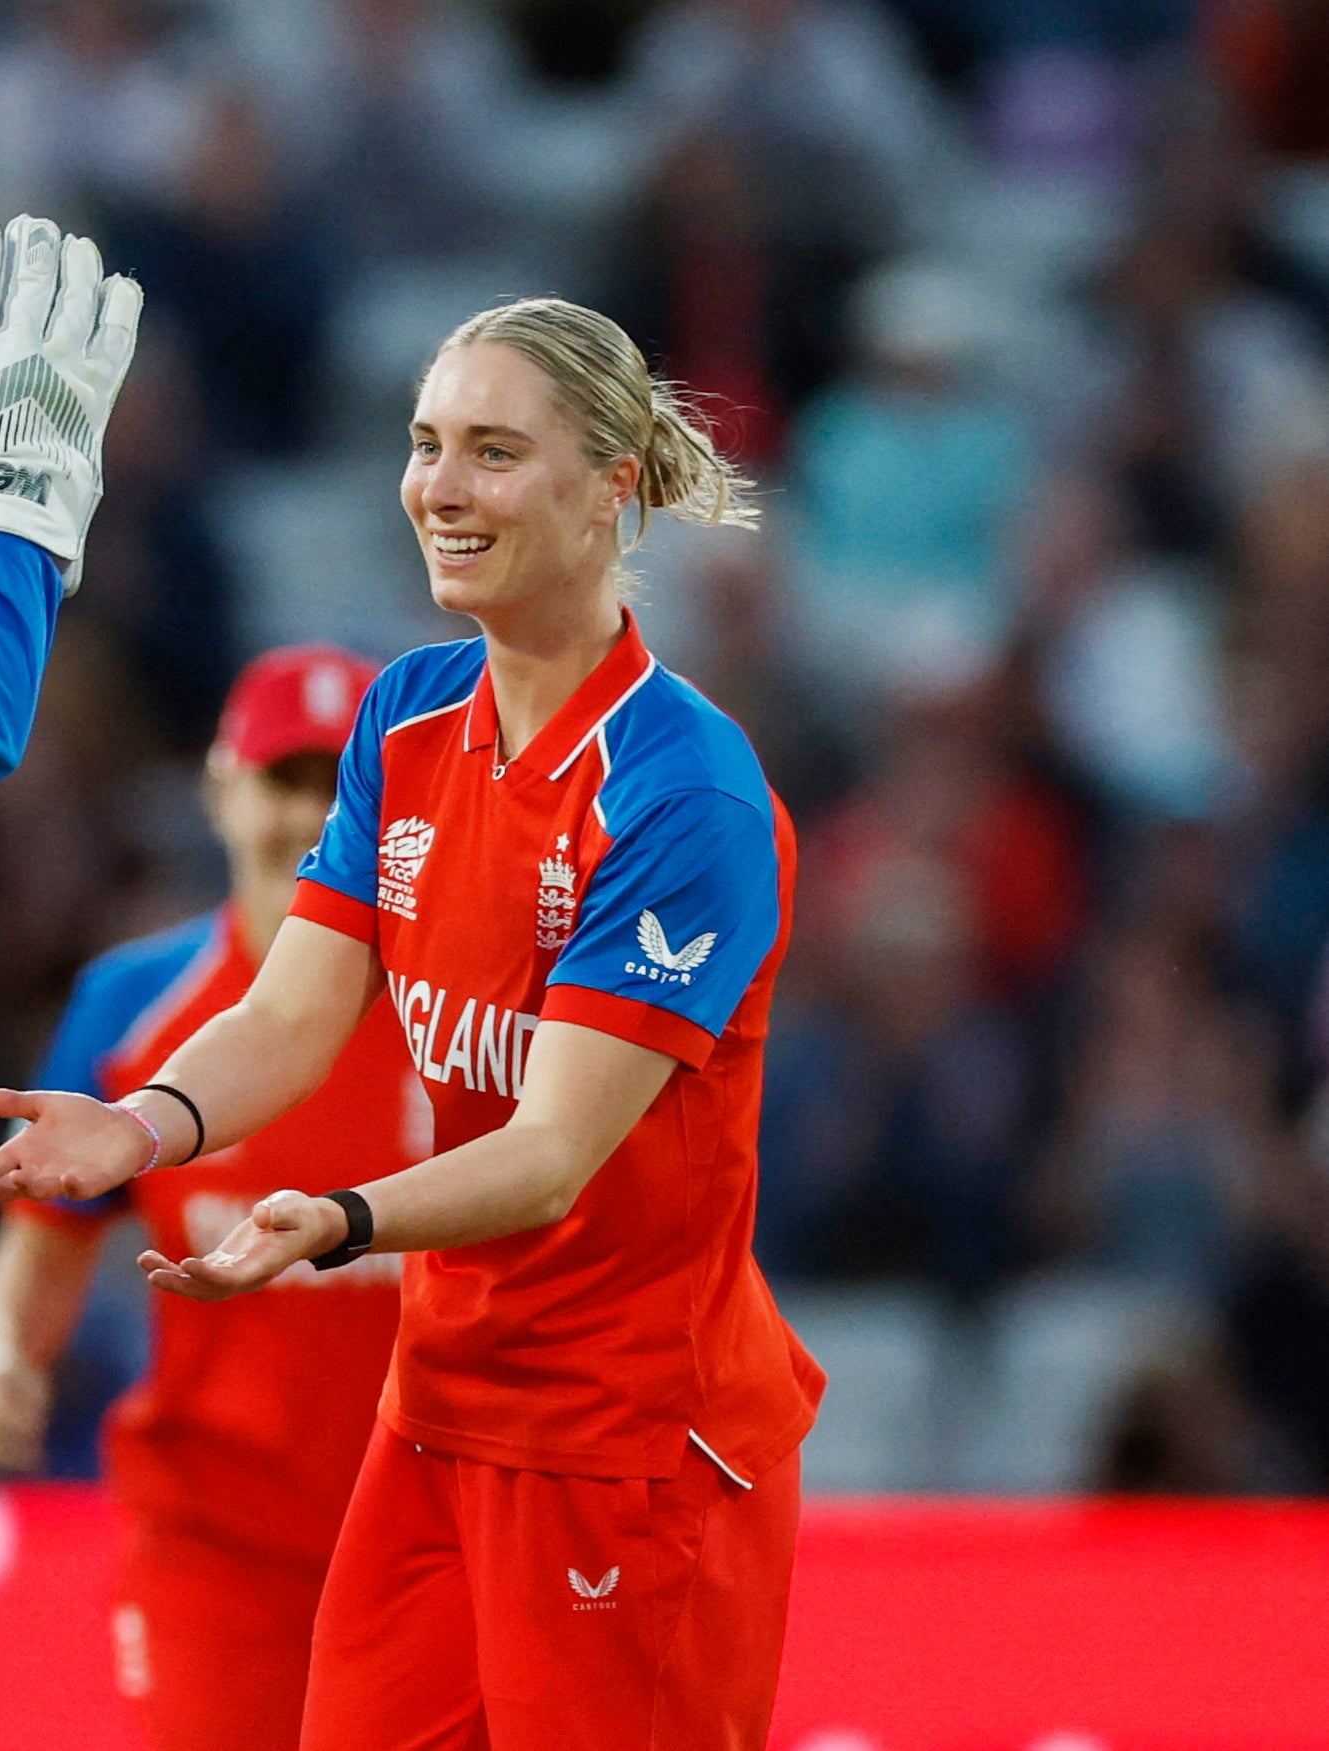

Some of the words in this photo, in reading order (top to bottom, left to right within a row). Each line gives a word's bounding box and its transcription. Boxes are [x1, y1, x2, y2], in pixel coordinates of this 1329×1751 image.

[388, 865, 413, 883] ICC
[624, 961, 695, 986] CASTOR
[387, 970, 540, 1101] NGLAND
